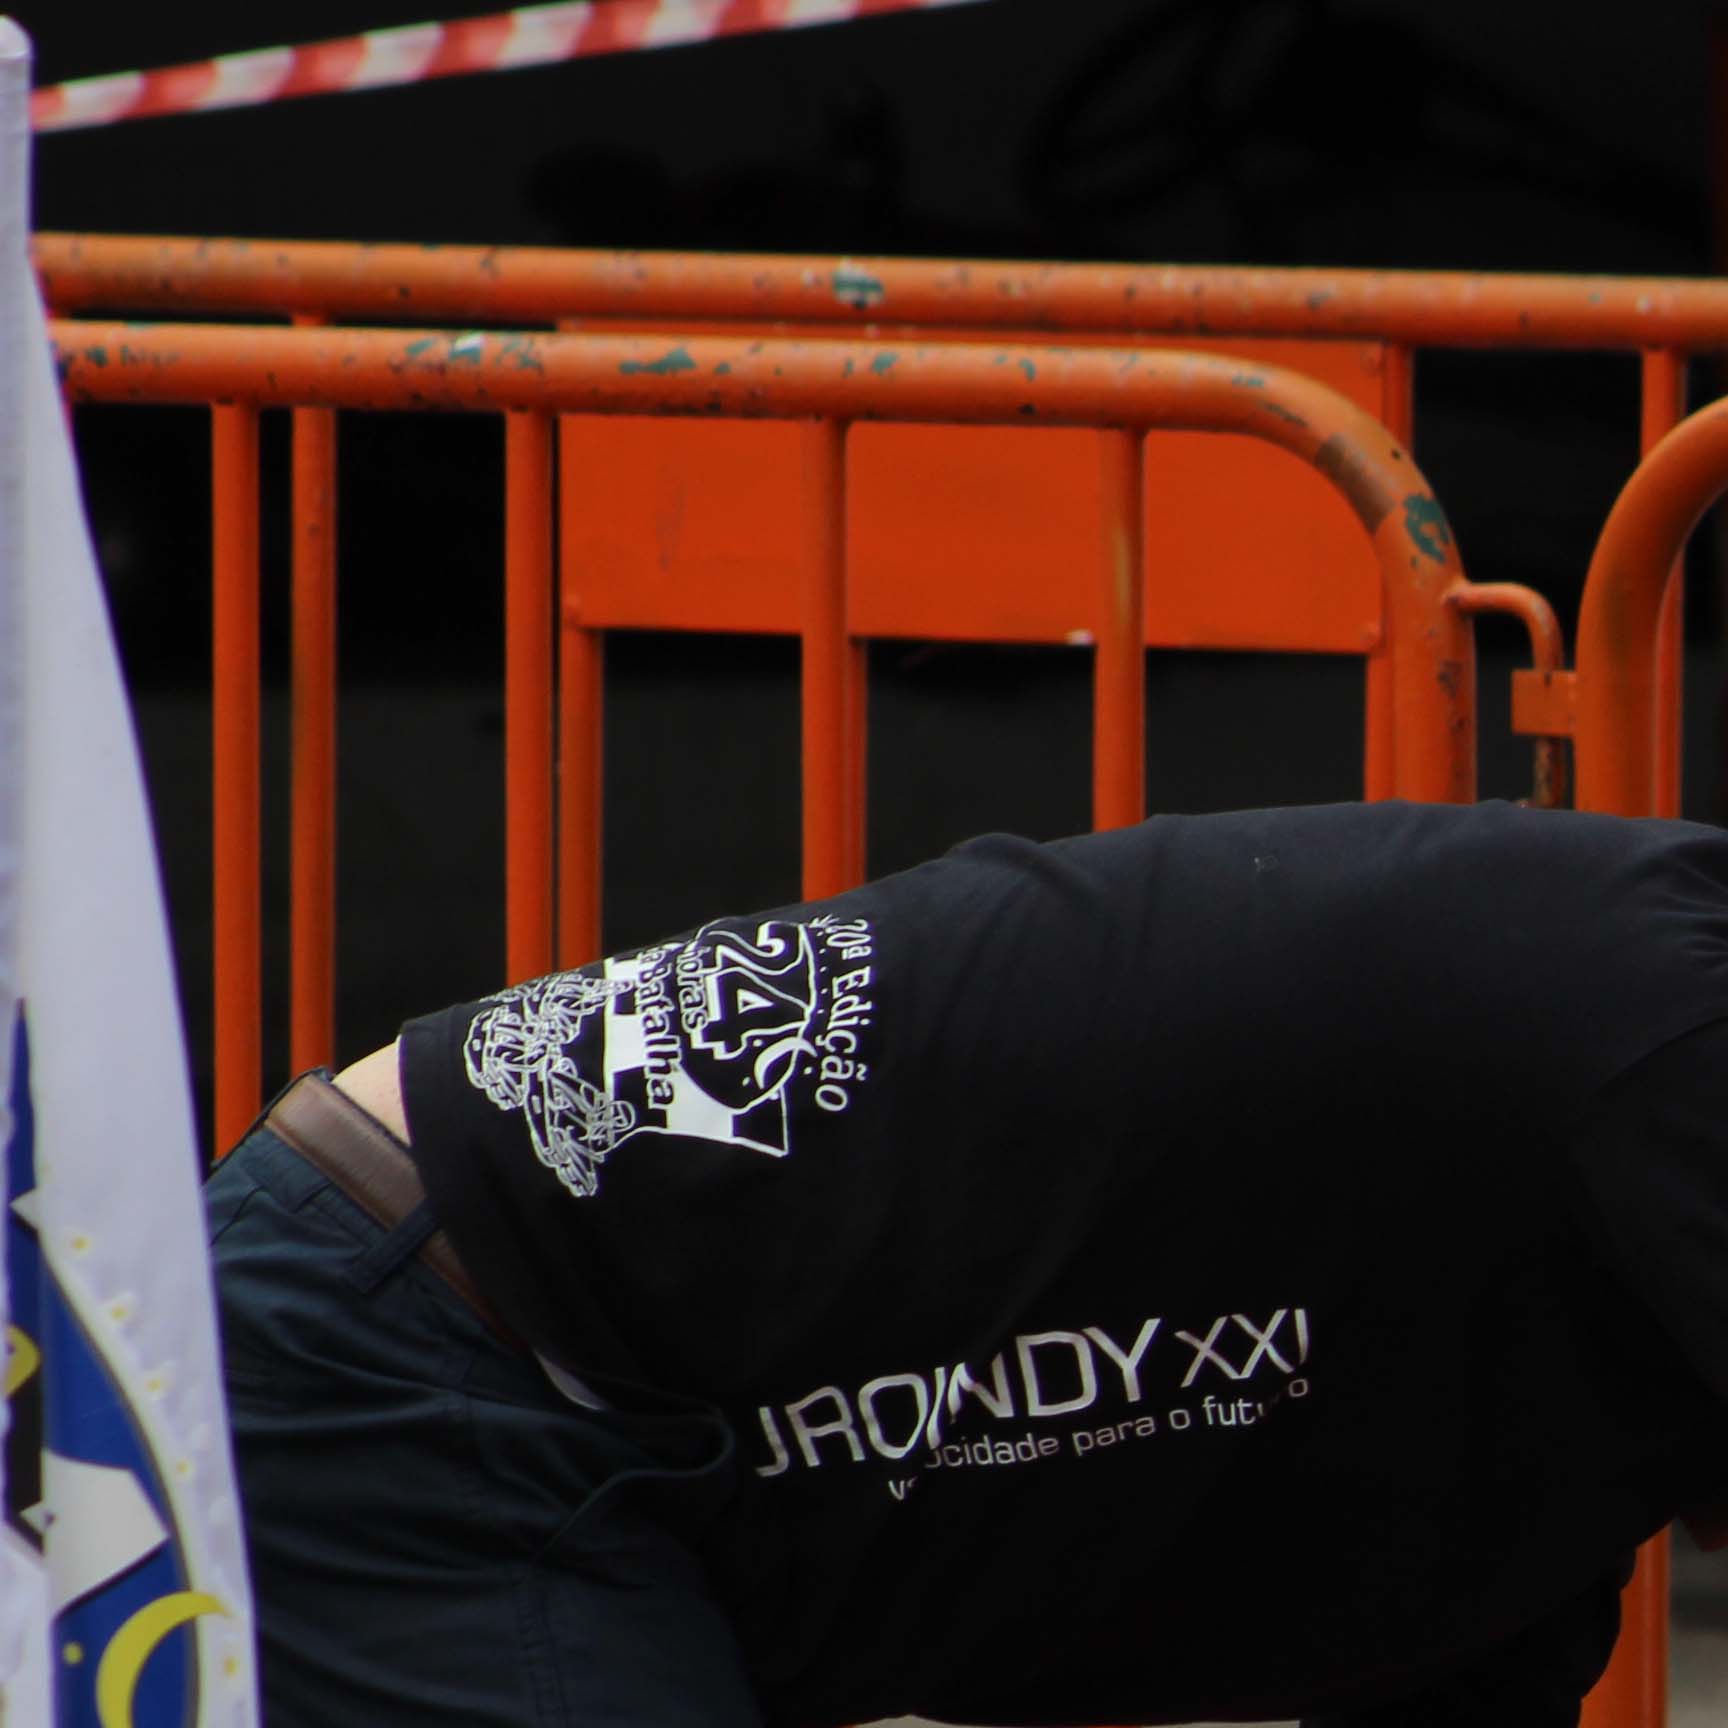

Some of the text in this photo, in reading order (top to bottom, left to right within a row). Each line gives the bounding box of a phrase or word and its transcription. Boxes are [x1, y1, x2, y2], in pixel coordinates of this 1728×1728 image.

[635, 963, 682, 1110] Batalha
[690, 920, 812, 1060] 24
[815, 966, 872, 1112] Edição
[1072, 1412, 1157, 1457] para
[1169, 1407, 1192, 1431] o
[1202, 1377, 1309, 1428] futo
[1173, 1308, 1309, 1389] XXI
